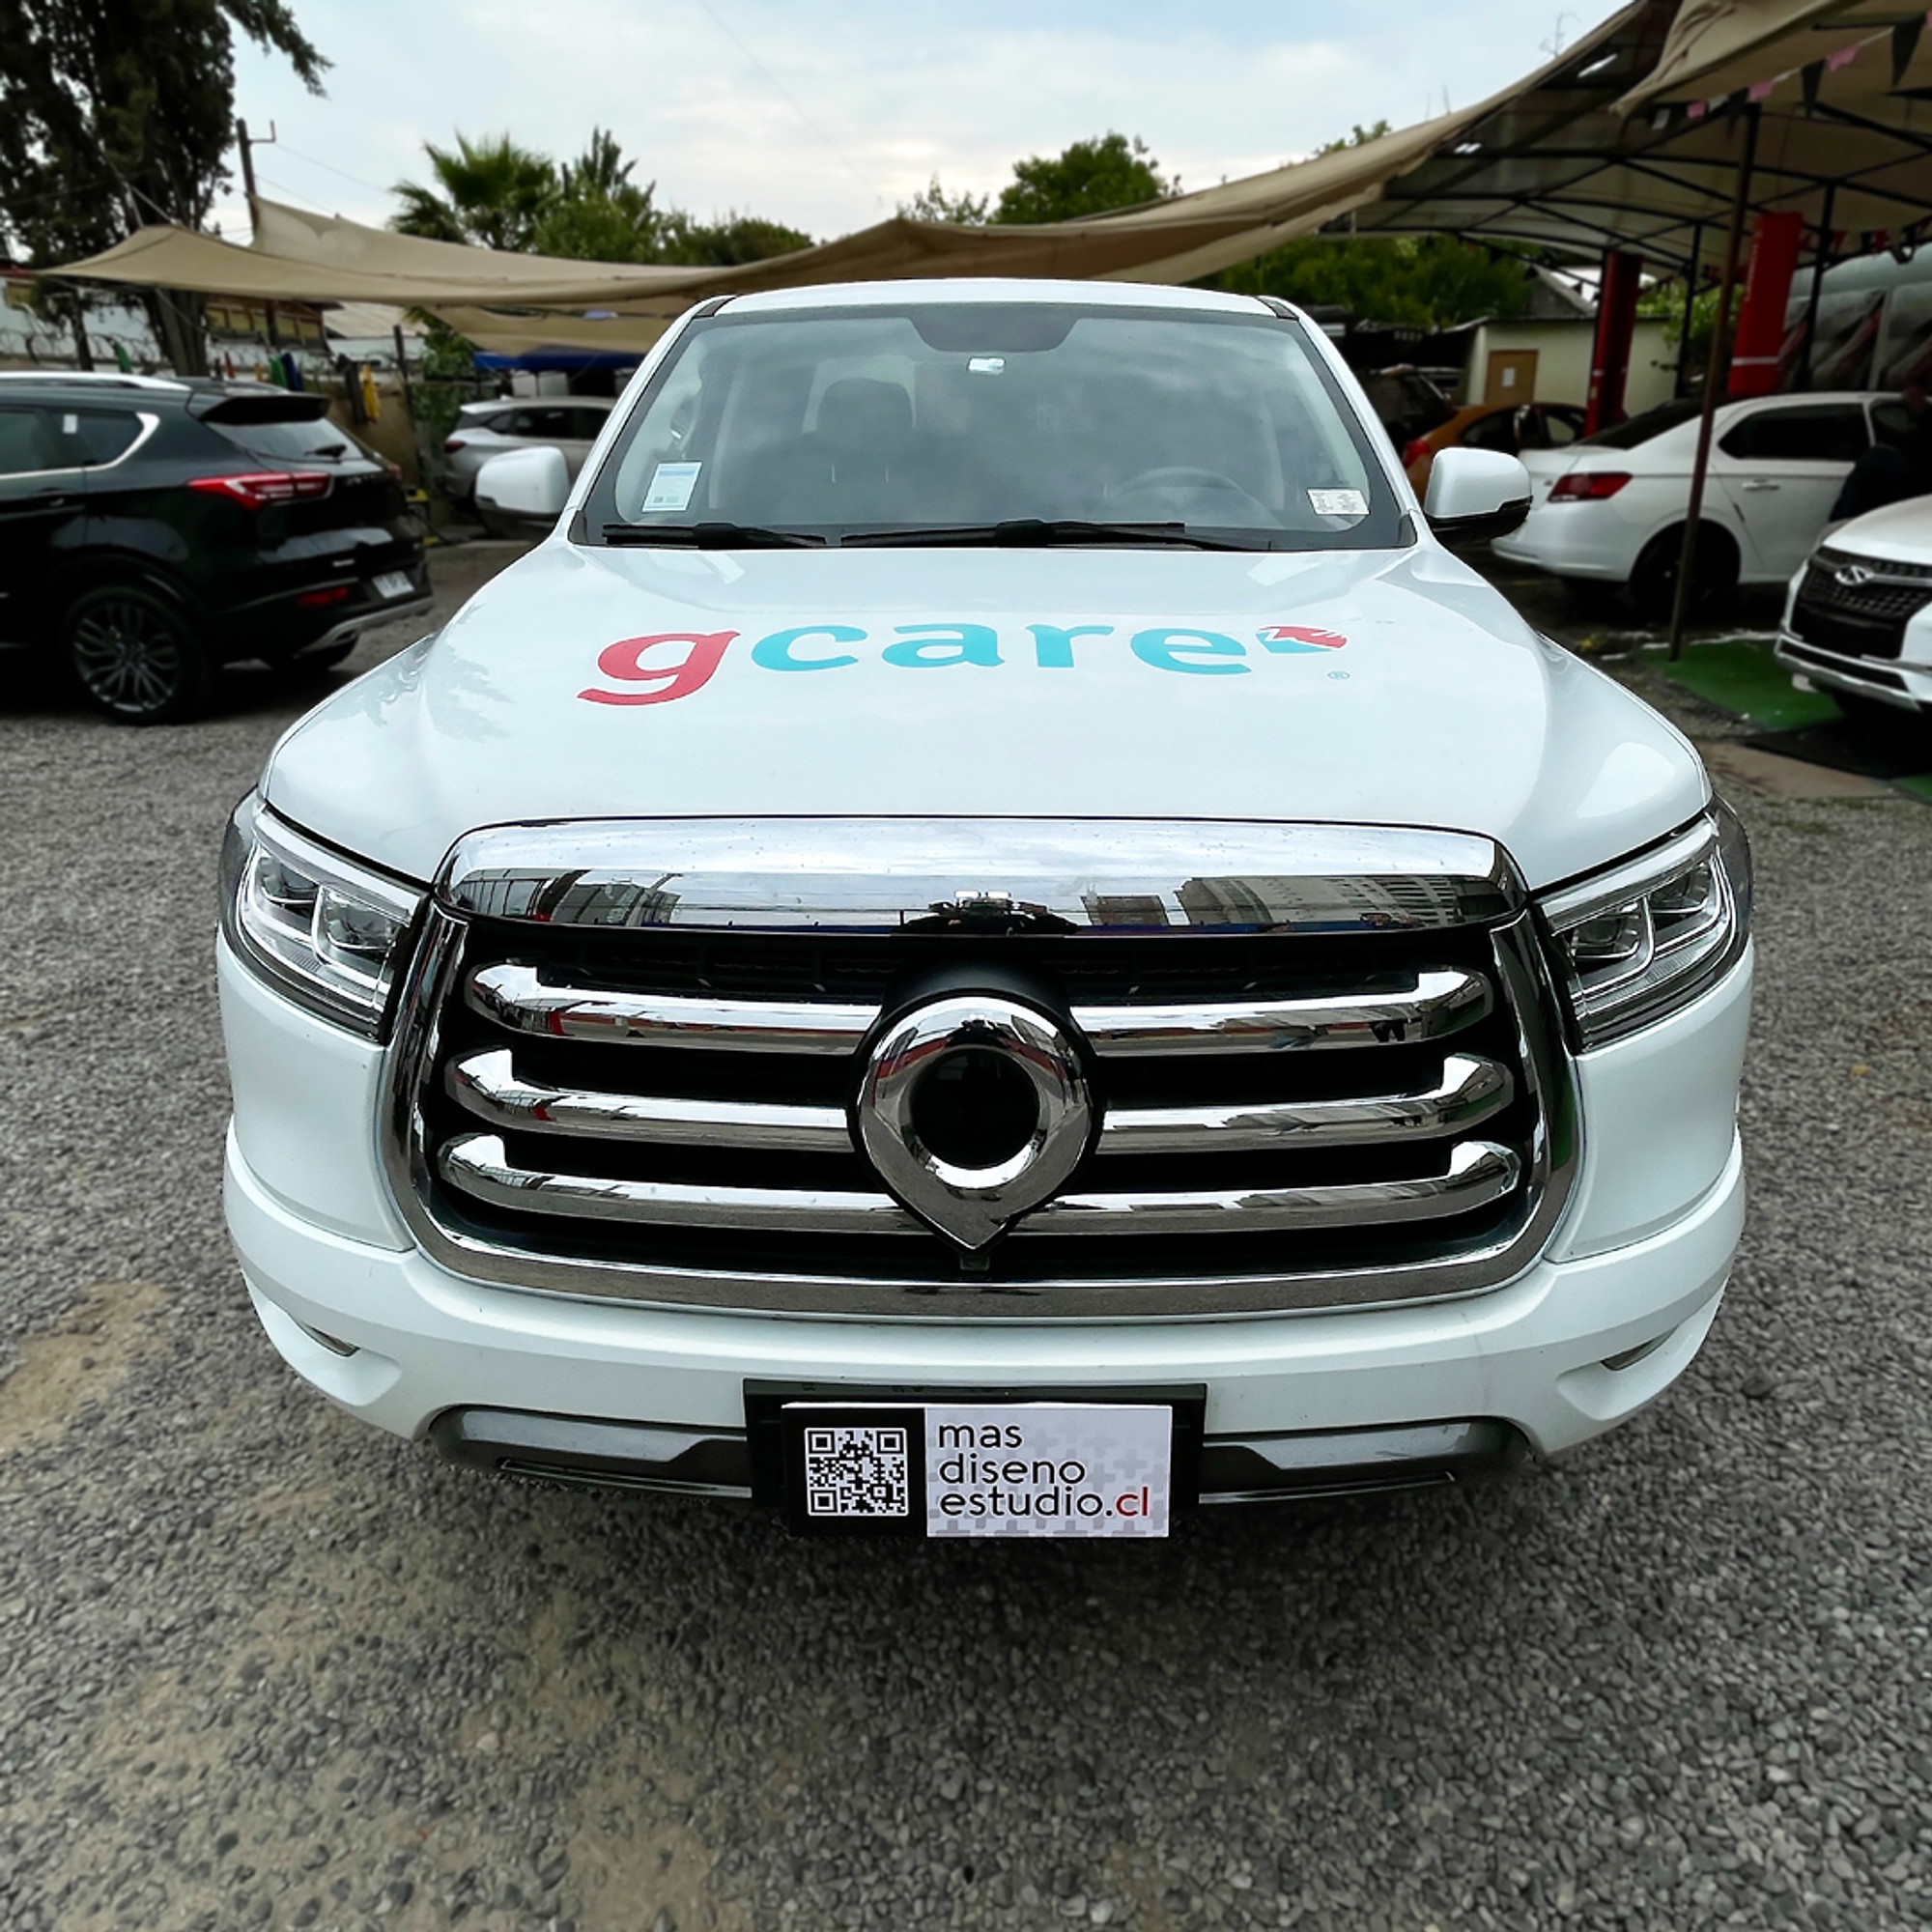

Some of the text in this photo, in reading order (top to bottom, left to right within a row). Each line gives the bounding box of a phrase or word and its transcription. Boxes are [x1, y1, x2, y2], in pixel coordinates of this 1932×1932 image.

[577, 622, 1252, 706] gcare
[939, 1425, 1023, 1449] mas
[939, 1453, 1086, 1485] diseno
[940, 1486, 1149, 1517] estudio.cl
